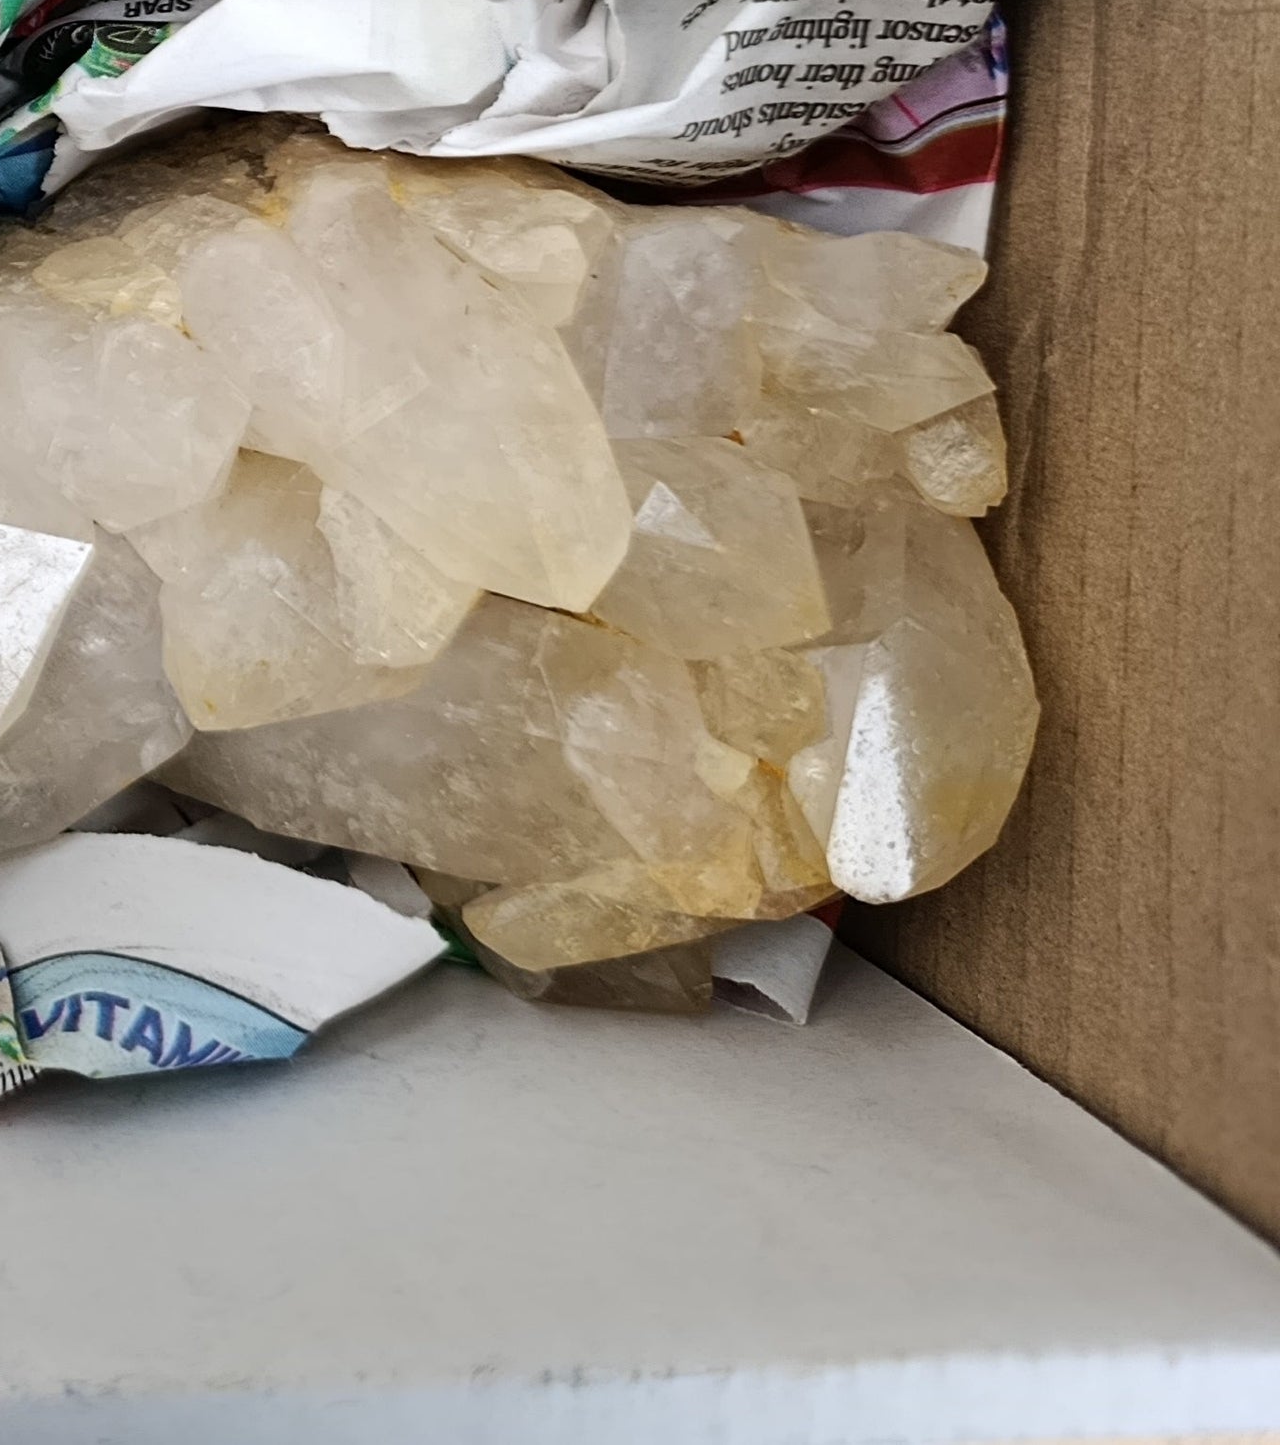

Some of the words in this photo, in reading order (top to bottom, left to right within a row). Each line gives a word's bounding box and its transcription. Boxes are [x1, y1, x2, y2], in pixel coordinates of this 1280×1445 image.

[723, 27, 770, 61] and
[768, 15, 869, 51] lighting
[721, 63, 787, 94] homes
[793, 62, 863, 91] their
[756, 100, 867, 129] esidents
